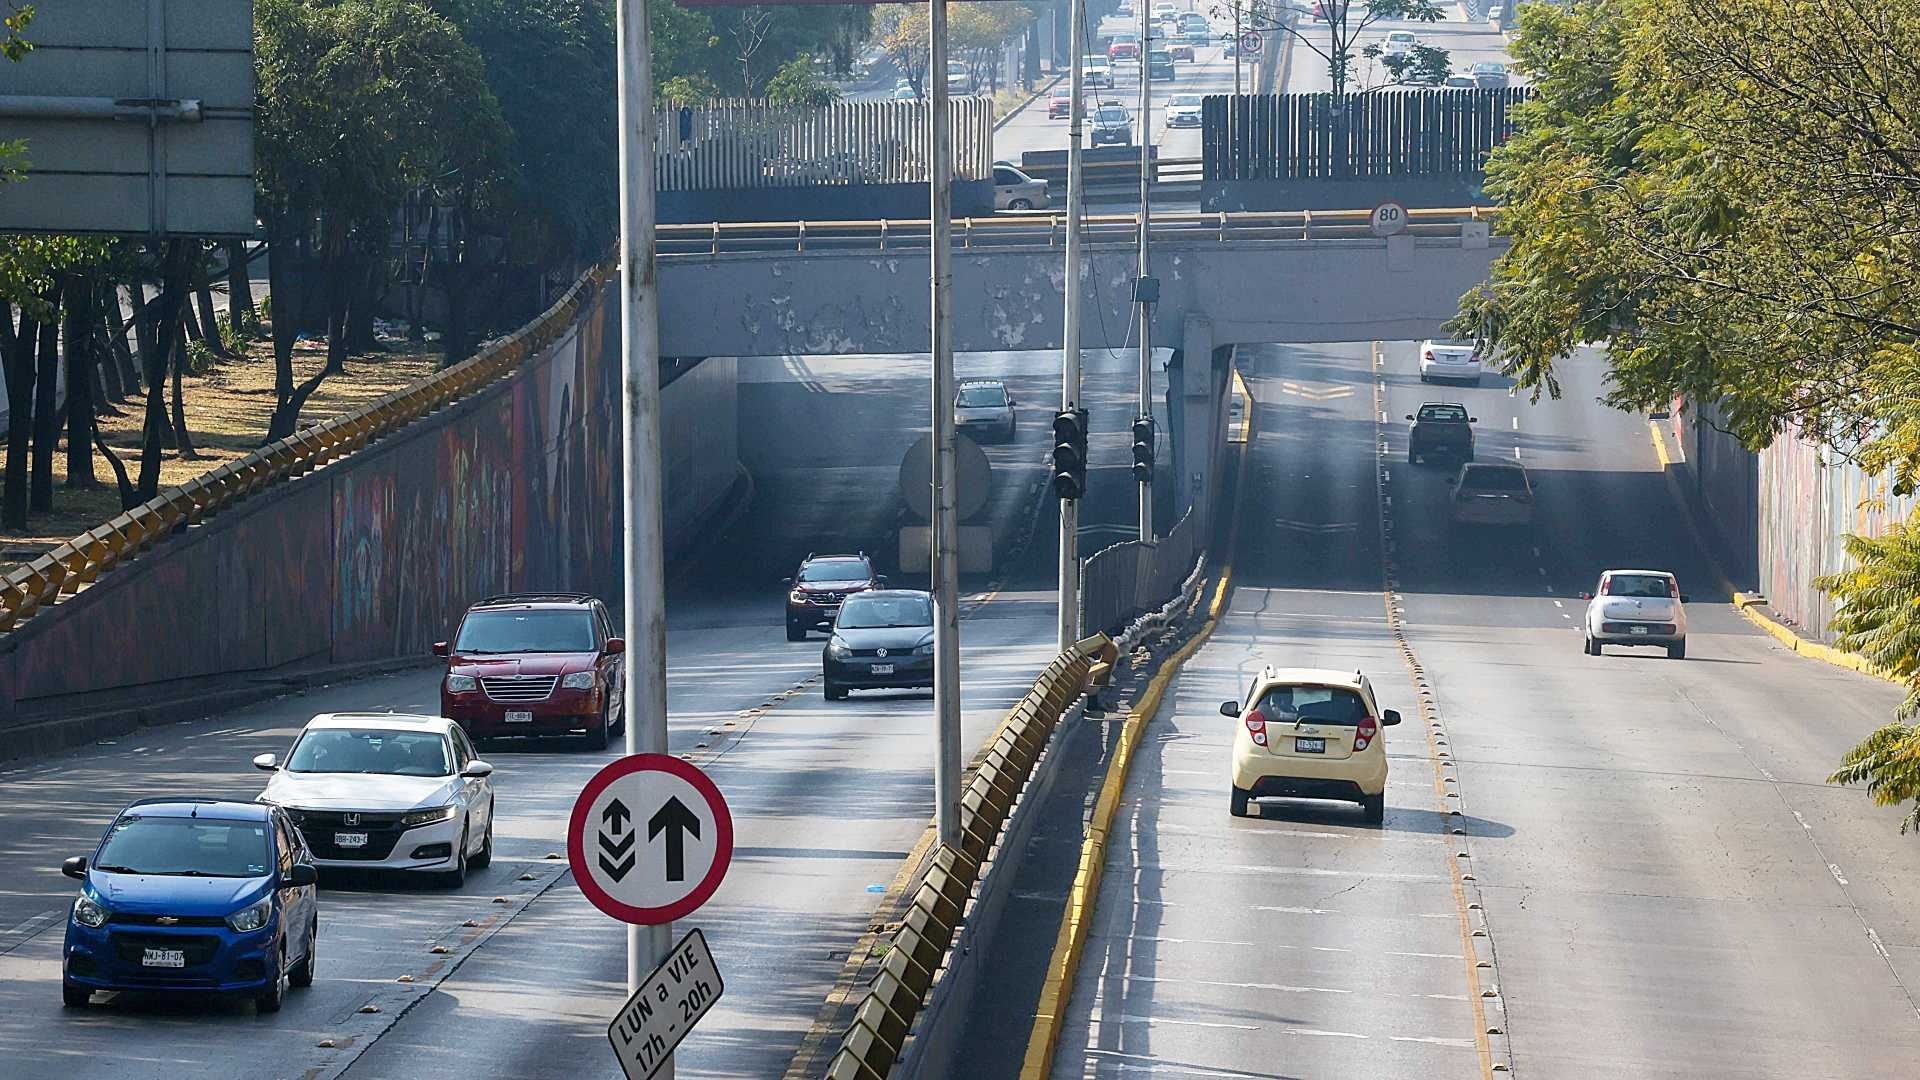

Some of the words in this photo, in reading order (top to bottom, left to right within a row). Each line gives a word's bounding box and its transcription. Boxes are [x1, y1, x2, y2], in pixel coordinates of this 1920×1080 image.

[1380, 208, 1398, 221] 80
[618, 995, 653, 1046] LUN
[656, 983, 669, 1002] a
[667, 944, 699, 984] VIE
[635, 1033, 666, 1073] 17h
[669, 1024, 676, 1032] -
[678, 980, 712, 1023] 20h
